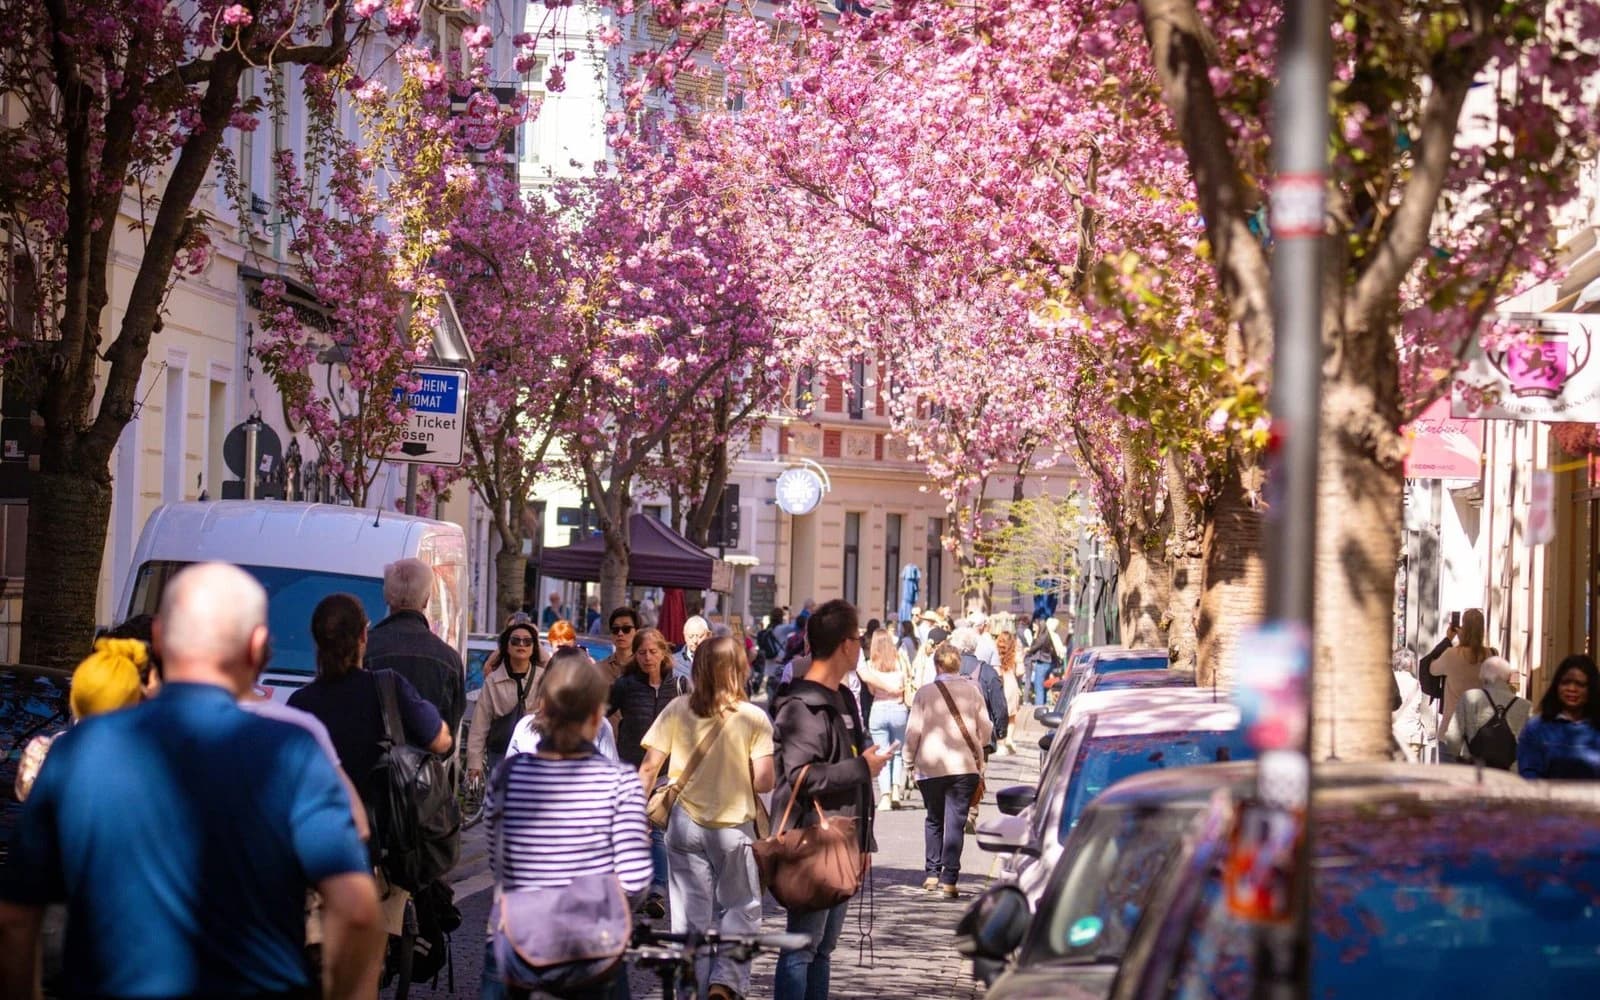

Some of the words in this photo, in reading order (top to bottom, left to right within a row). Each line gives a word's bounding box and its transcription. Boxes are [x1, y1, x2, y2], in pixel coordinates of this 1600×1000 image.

[423, 379, 454, 392] HEIN-
[395, 393, 442, 408] ATOMAT
[415, 415, 456, 430] Ticket
[401, 428, 434, 441] ösen
